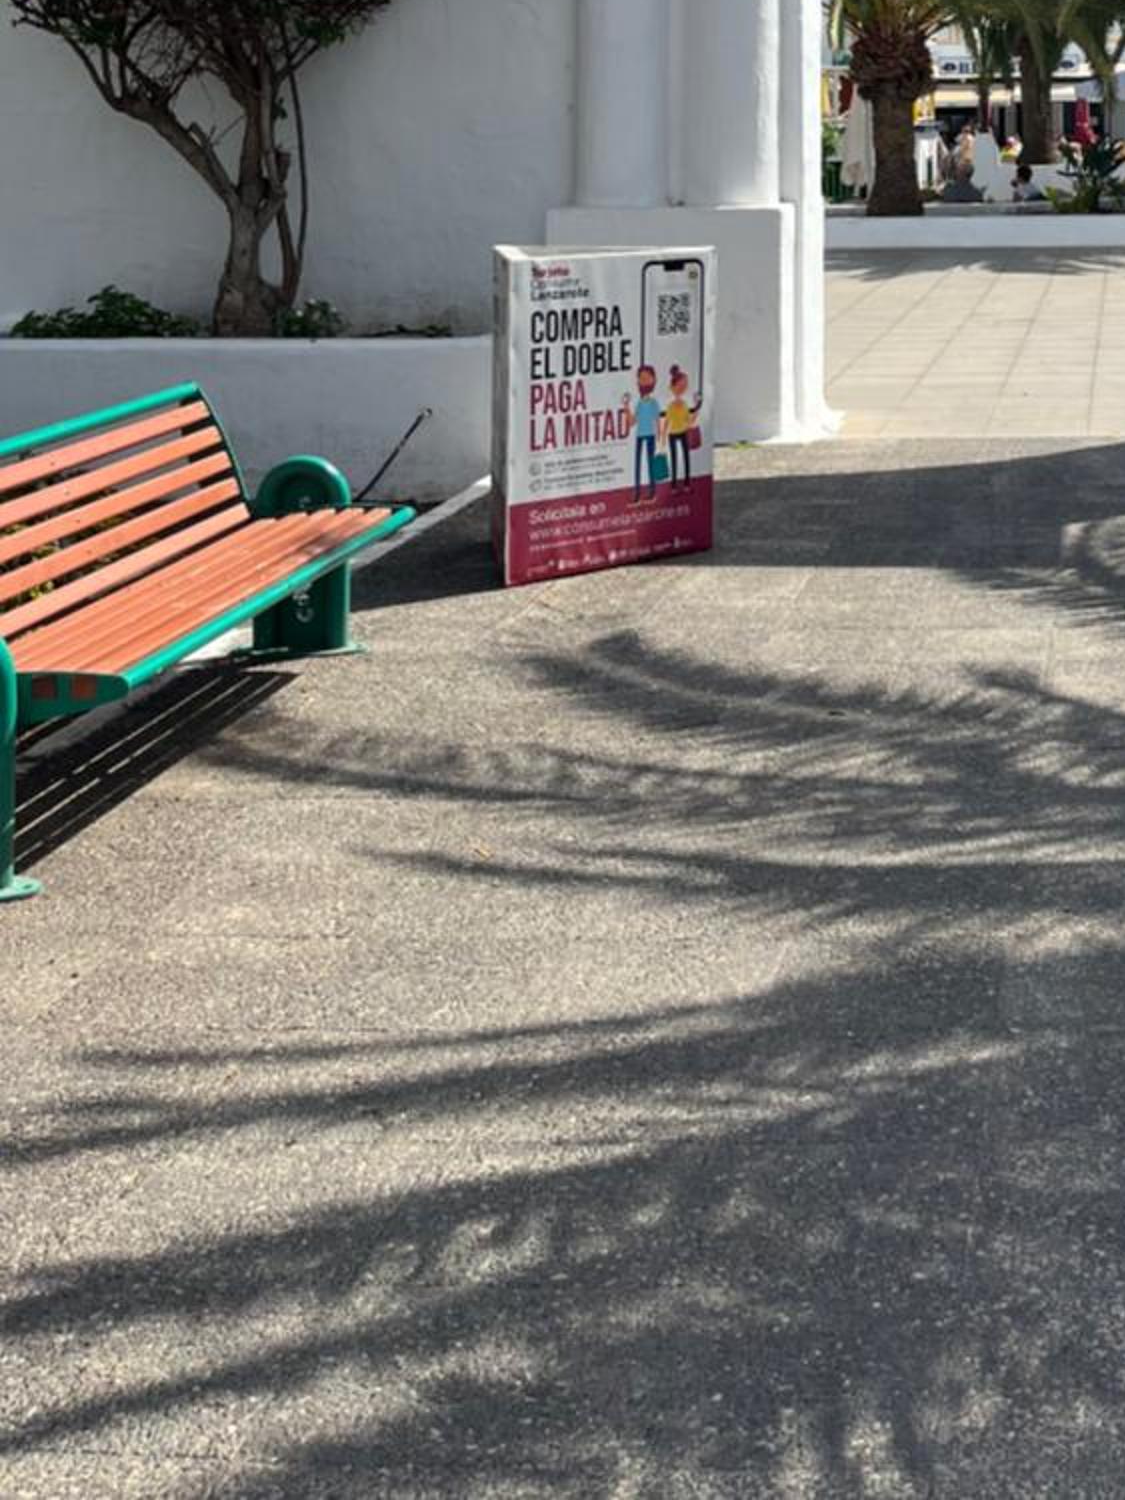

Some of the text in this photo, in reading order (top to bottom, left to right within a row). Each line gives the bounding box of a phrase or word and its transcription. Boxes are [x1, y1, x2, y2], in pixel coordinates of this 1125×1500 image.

[530, 305, 623, 345] COMPRA
[530, 339, 632, 381] EL DOBLE
[529, 379, 587, 416] PAGA
[528, 407, 631, 452] LA MITAD
[588, 501, 607, 516] en
